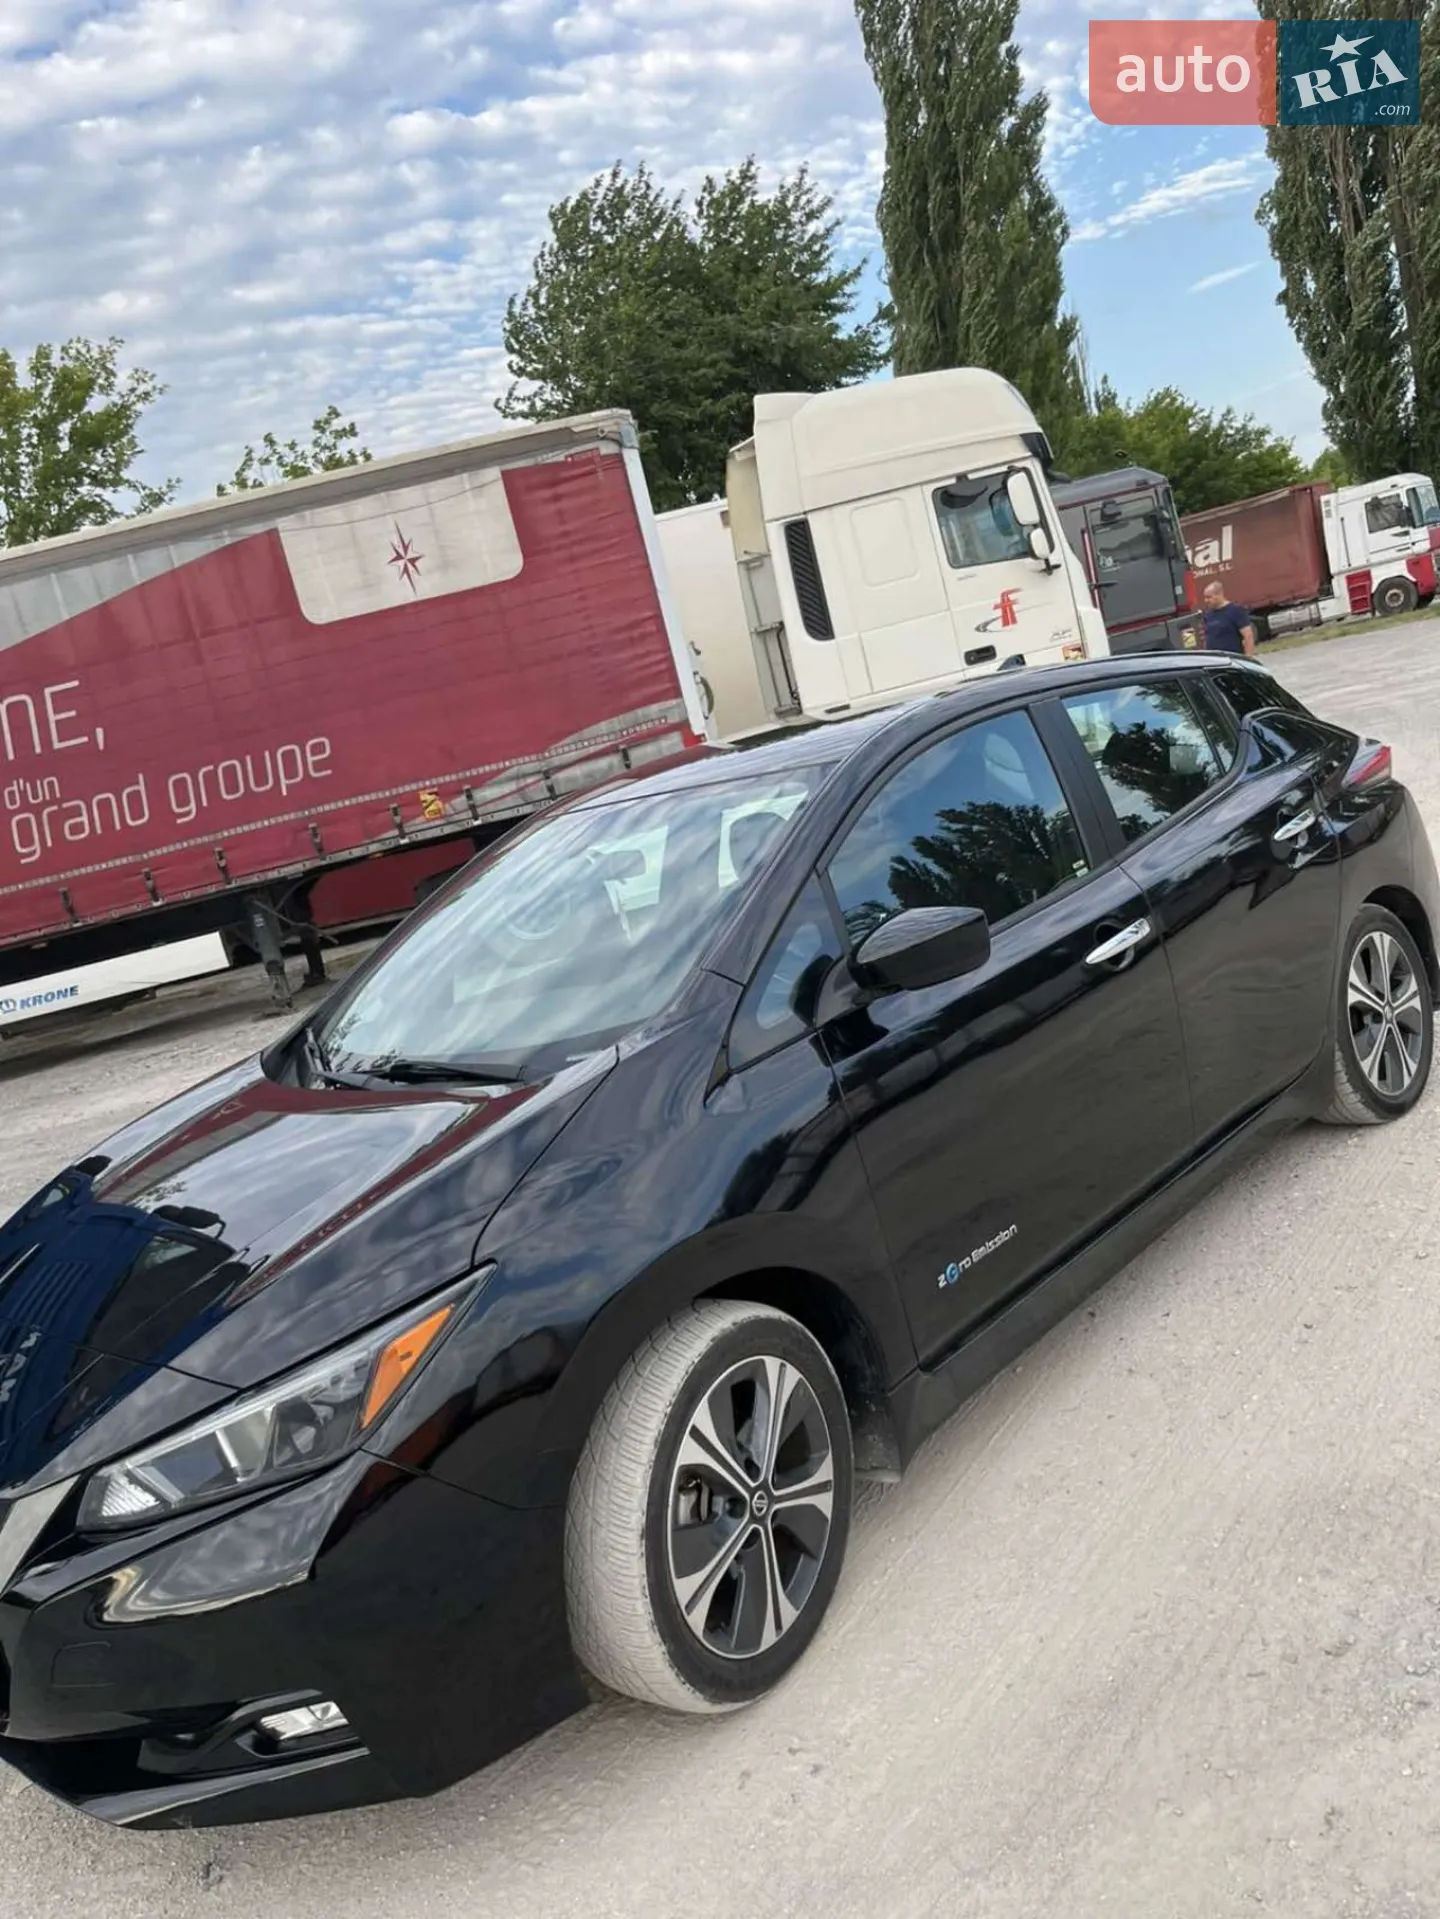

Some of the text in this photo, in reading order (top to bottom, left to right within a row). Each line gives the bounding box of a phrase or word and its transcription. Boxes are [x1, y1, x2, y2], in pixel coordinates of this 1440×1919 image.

[3, 776, 61, 810] d'un
[11, 736, 333, 865] grand groupe
[20, 984, 79, 1010] KRONE
